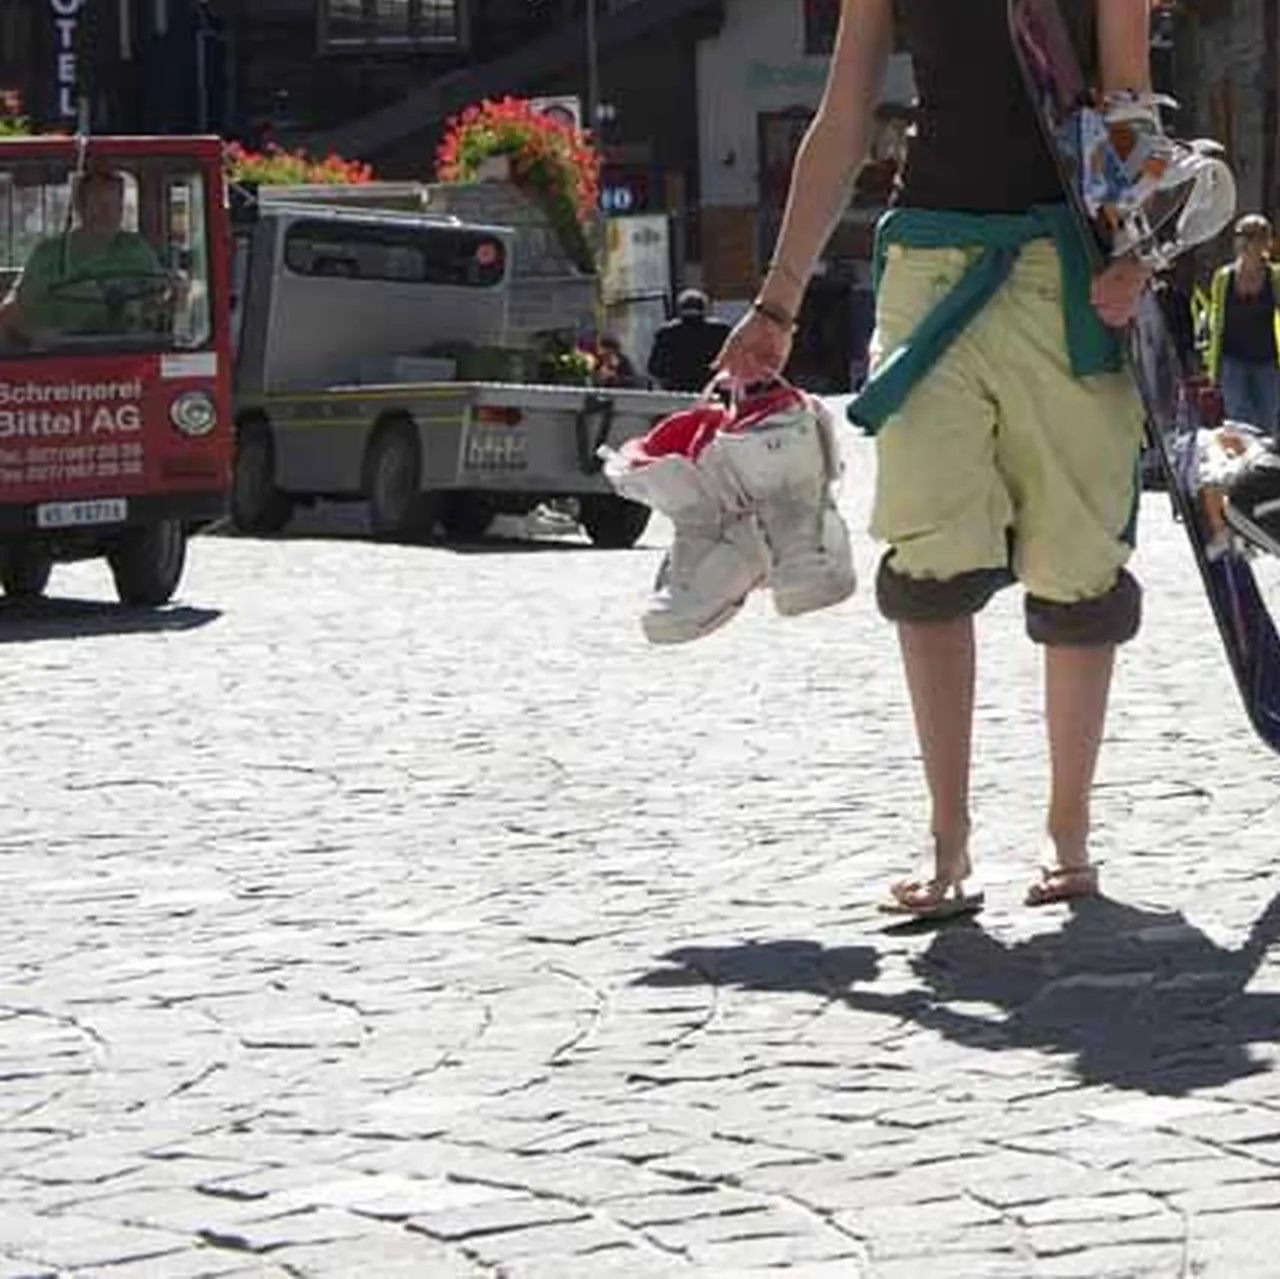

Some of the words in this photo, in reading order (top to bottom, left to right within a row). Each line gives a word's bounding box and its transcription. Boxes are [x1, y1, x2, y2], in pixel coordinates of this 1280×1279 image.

[0, 378, 142, 404] Schreinerei
[0, 408, 81, 437] Bittel
[92, 404, 142, 435] AG
